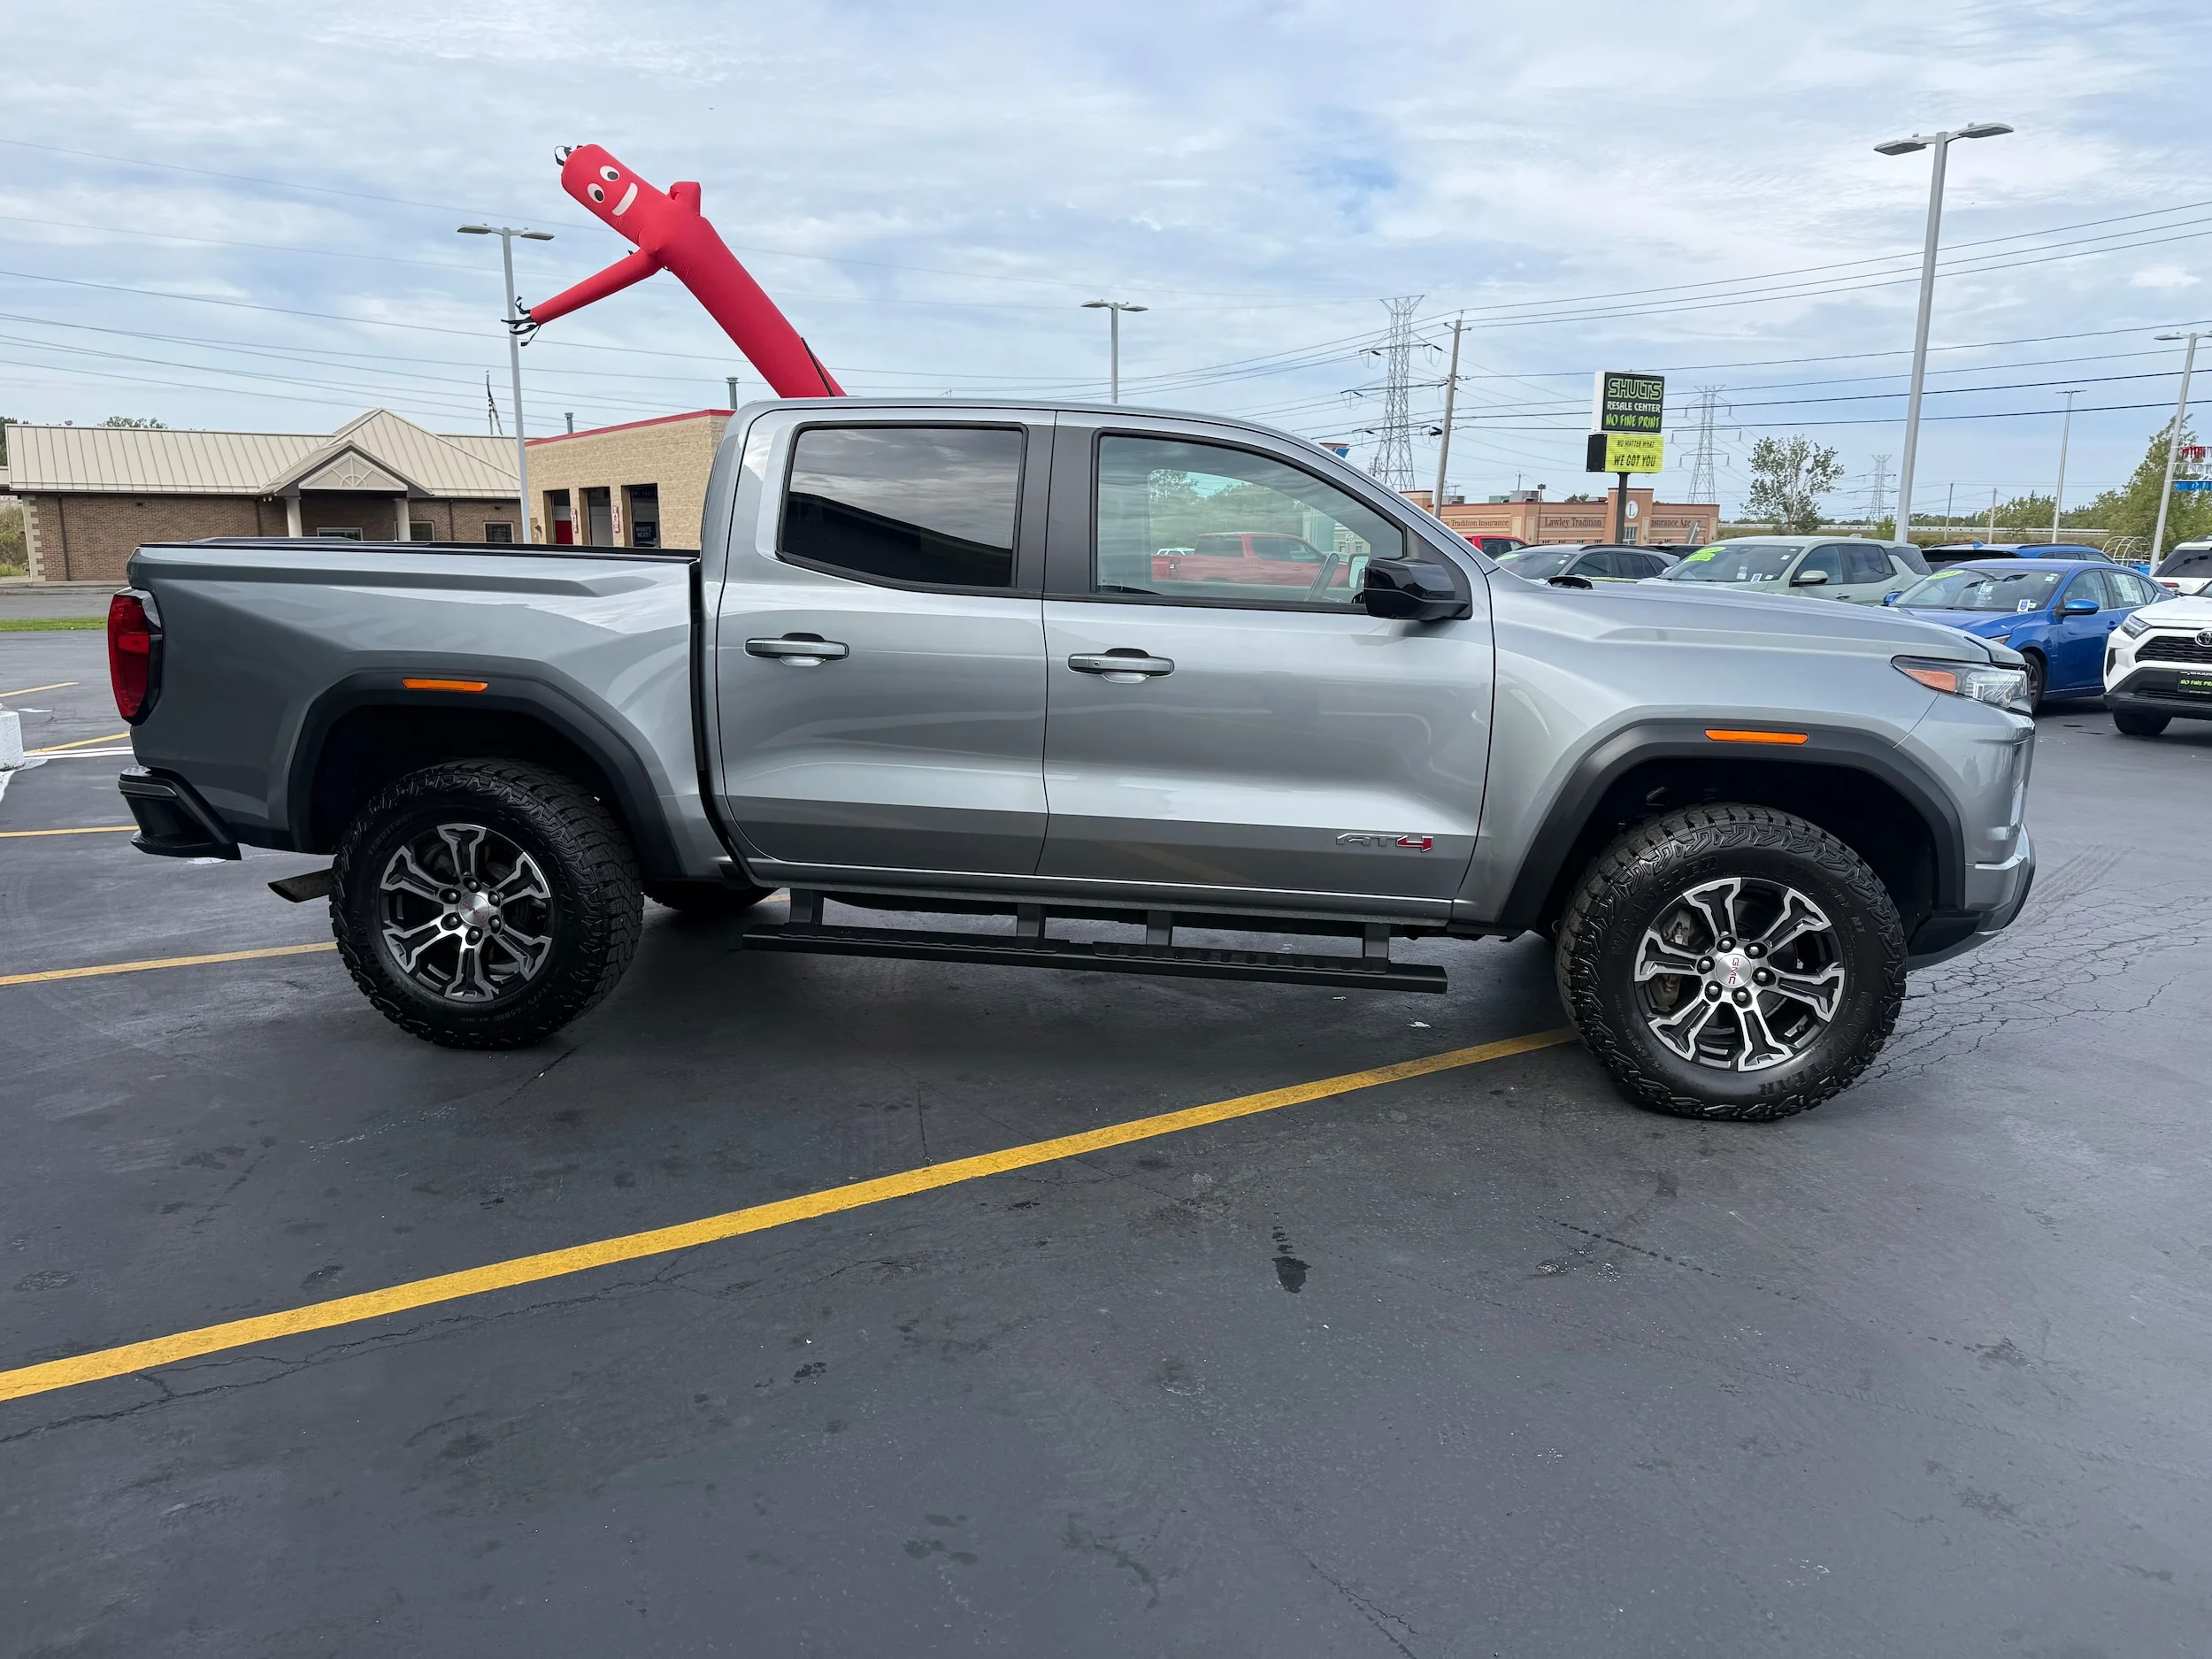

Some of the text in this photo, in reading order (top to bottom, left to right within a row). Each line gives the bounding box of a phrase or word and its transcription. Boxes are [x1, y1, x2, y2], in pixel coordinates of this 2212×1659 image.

[1608, 377, 1663, 401] SHULTS
[1607, 401, 1661, 413] RESALE CENTER
[1605, 413, 1661, 429] NO FINE PRINT
[1613, 454, 1656, 467] WE GOT YOU
[1544, 517, 1601, 528] Lawley Tradition
[1335, 832, 1434, 853] AT4
[1728, 957, 1740, 985] GMC
